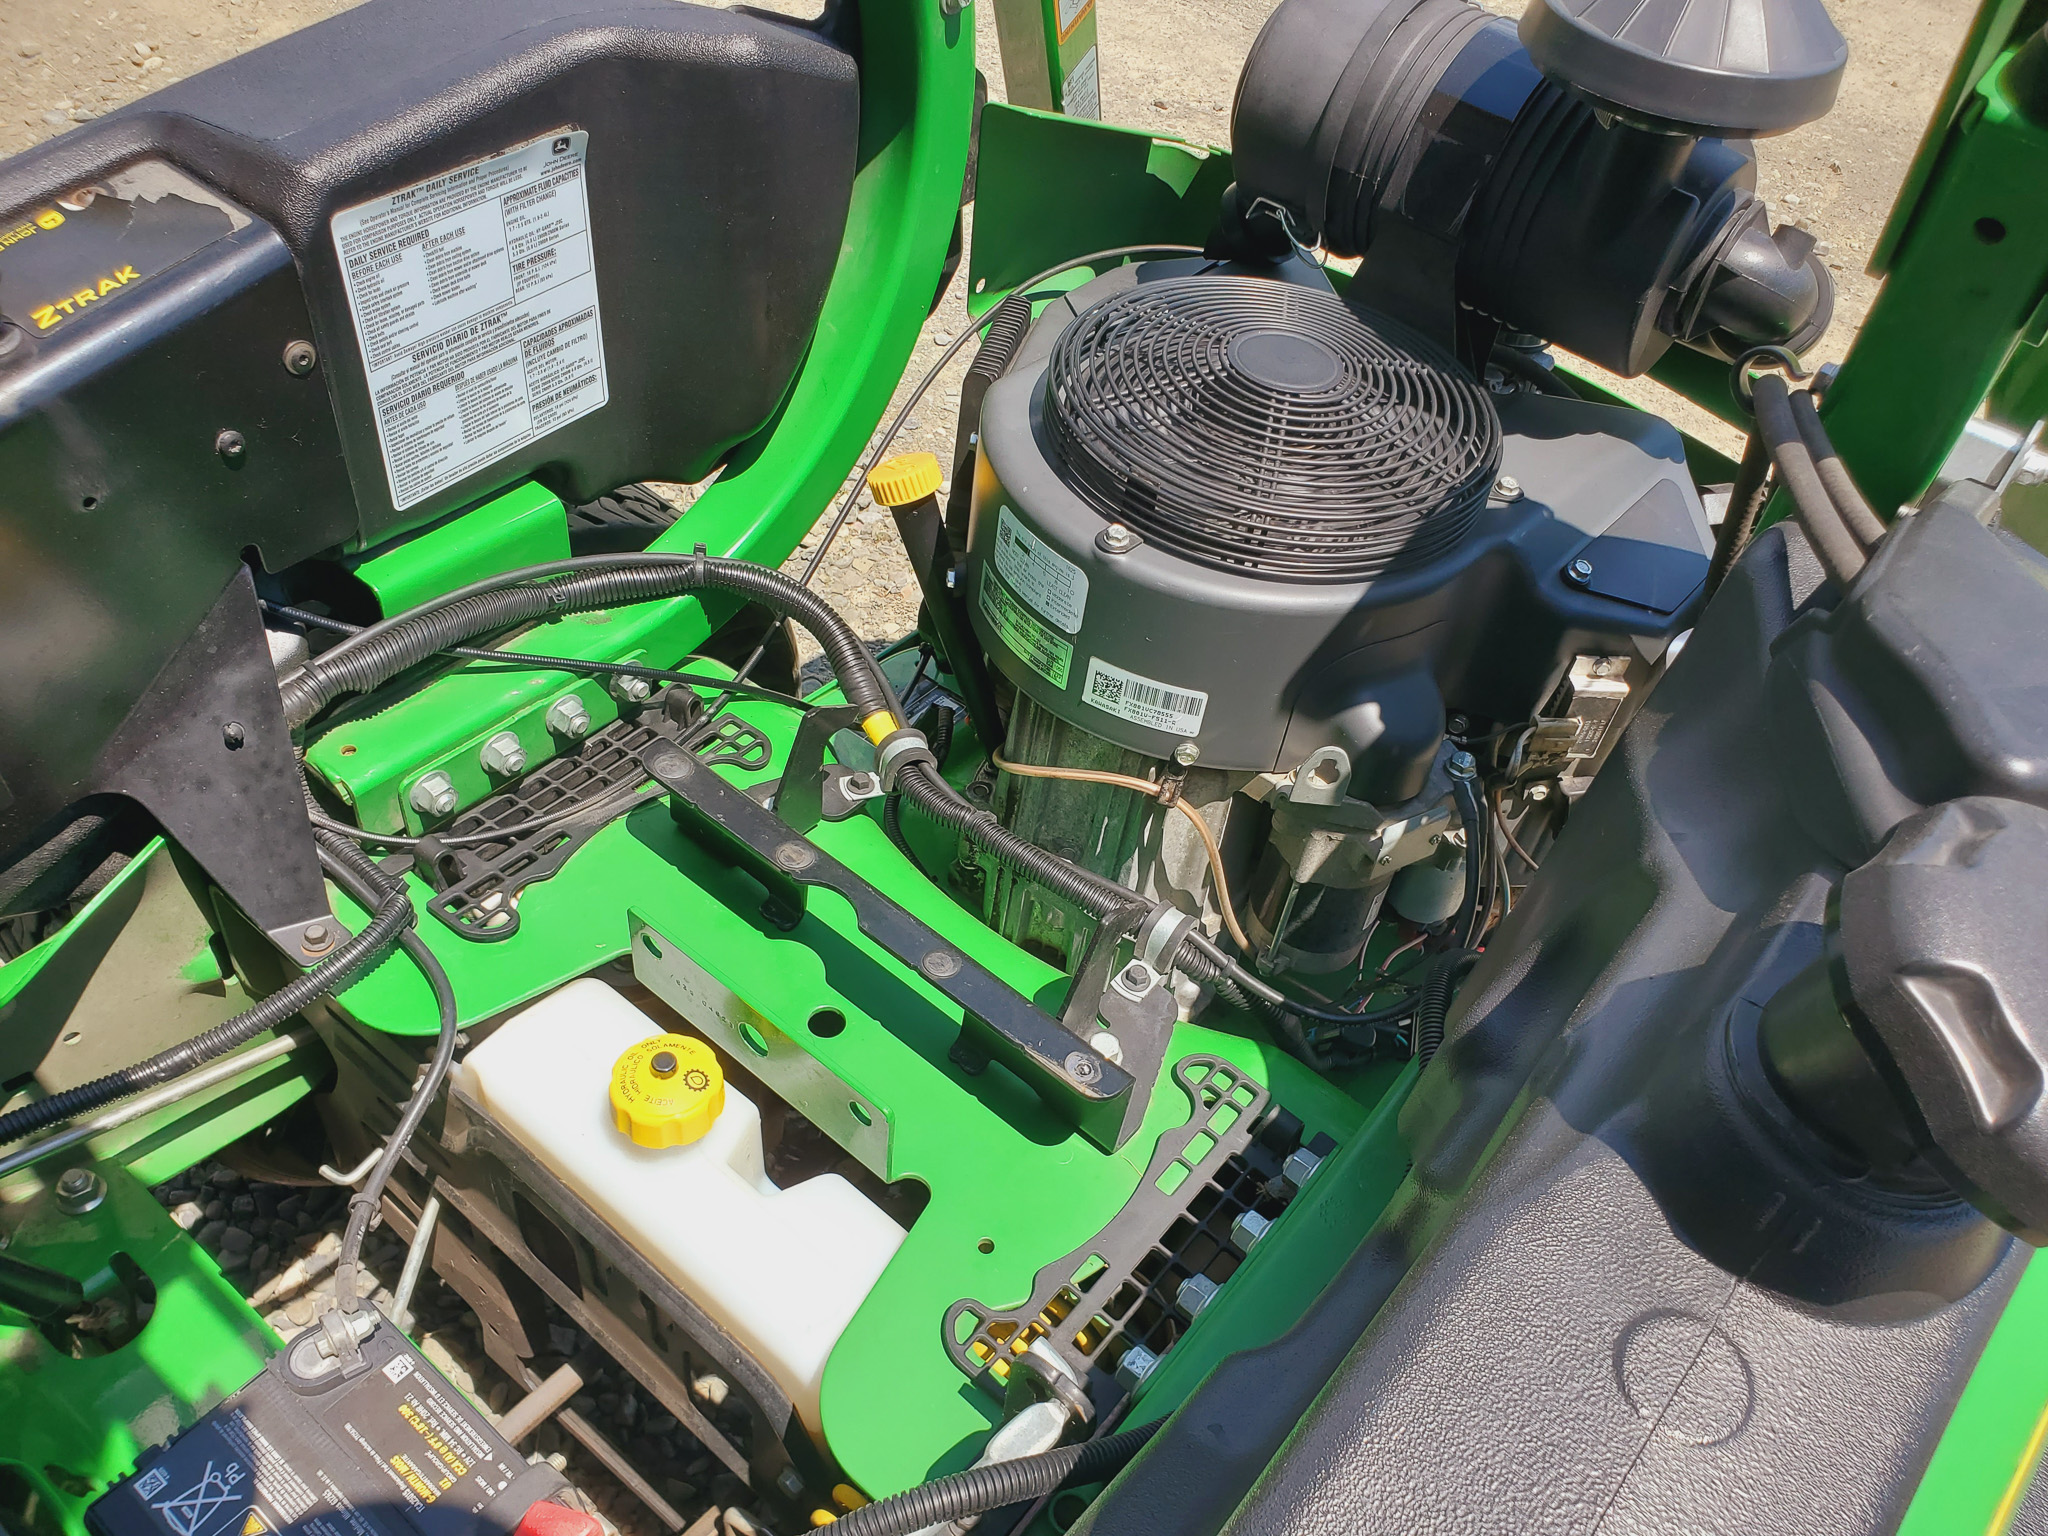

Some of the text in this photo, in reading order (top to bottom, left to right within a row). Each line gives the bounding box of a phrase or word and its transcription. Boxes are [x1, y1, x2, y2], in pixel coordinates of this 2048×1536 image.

[542, 149, 578, 168] JOHN DEERE
[425, 177, 447, 193] DAILY
[448, 165, 480, 184] SERVICE
[502, 167, 579, 206] APPROXIMATE FLUID CAPACITIES
[504, 188, 556, 217] (WITH FILTER CHANGE)
[348, 228, 429, 268] DAILY SERVICE REQUIRED
[421, 226, 465, 250] AFTER EACH USE
[351, 252, 402, 279] BEFORE EACH USE
[512, 247, 556, 272] TIRE PRESSURE:
[30, 265, 141, 331] ZTRAK
[522, 309, 593, 348] CAPACIDADES APROXIMADAS
[411, 341, 443, 362] SERVICIO
[445, 329, 468, 347] DIARIO
[470, 325, 478, 336] DE
[524, 337, 554, 358] DE FLUIDOS
[525, 332, 587, 368] (INCLUYE CAMBIO DE FILTRO)
[381, 370, 464, 416] SERVICIO DIARIO REQUERIDO
[531, 392, 554, 412] PRESIÓN
[554, 390, 562, 400] DE
[384, 400, 426, 425] ANTES DE CADA USO
[1090, 698, 1120, 714] KAWASAKI
[1130, 715, 1162, 728] ASSEMBLED
[1175, 726, 1188, 734] USA
[646, 1043, 697, 1055] SOLAMENTE
[620, 1039, 661, 1104] HYDRAULIC OIL ONLY
[644, 1095, 674, 1106] ACEITE
[404, 1391, 414, 1401] 21
[409, 1397, 420, 1408] Ah
[437, 1395, 445, 1404] ET
[397, 1402, 414, 1419] 300
[415, 1403, 430, 1419] 20HR
[440, 1400, 459, 1418] SERVICE
[454, 1414, 464, 1423] DE
[425, 1396, 486, 1459] INSTALLATION AND SERVICE RECORD
[459, 1419, 492, 1453] ENREGISTREMENT
[437, 1444, 449, 1455] @
[447, 1438, 458, 1448] 34
[453, 1443, 464, 1455] RC
[442, 1449, 457, 1465] (A)
[463, 1454, 476, 1468] 12V
[220, 1460, 246, 1486] Pb
[388, 1453, 437, 1504] 6-MONTH MOIS
[398, 1452, 443, 1497] WARRANTY/GARANTIE
[449, 1459, 468, 1477] CCA
[437, 1476, 452, 1491] U1
[473, 1474, 487, 1488] MOIS
[320, 1488, 339, 1506] 61265
[401, 1487, 426, 1512] TCA25015
